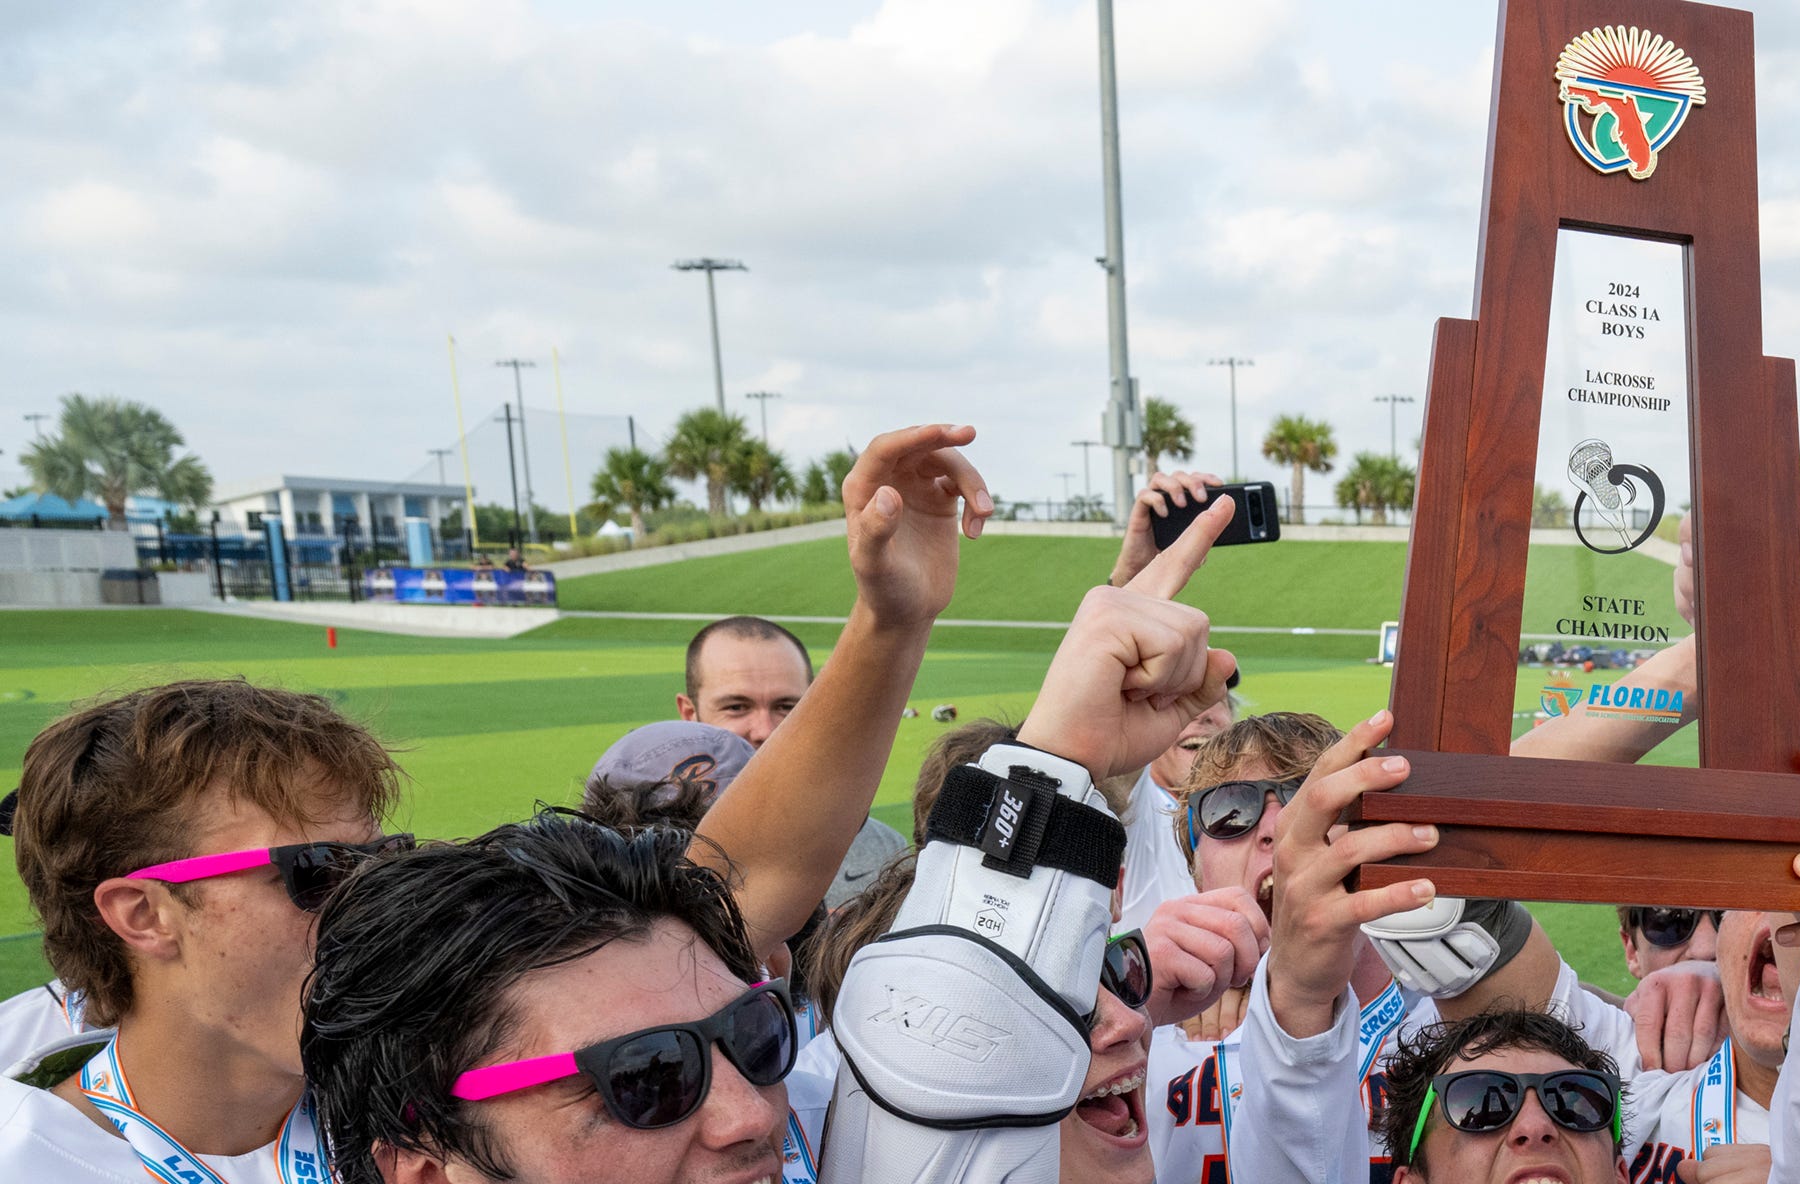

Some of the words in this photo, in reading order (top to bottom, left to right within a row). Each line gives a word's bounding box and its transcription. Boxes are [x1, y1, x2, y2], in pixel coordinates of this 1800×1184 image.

[1608, 282, 1640, 298] 2024
[1585, 300, 1637, 318] CLASS
[1642, 307, 1661, 321] 1A
[1601, 322, 1645, 339] BOYS
[1585, 370, 1655, 390] LACROSSE
[1568, 387, 1671, 412] CHAMPIONSHIP
[1582, 595, 1645, 616] STATE
[1556, 618, 1669, 643] CHAMPION
[1588, 684, 1684, 712] FLORIDA
[994, 789, 1023, 848] 360+
[977, 916, 1001, 932] HD2
